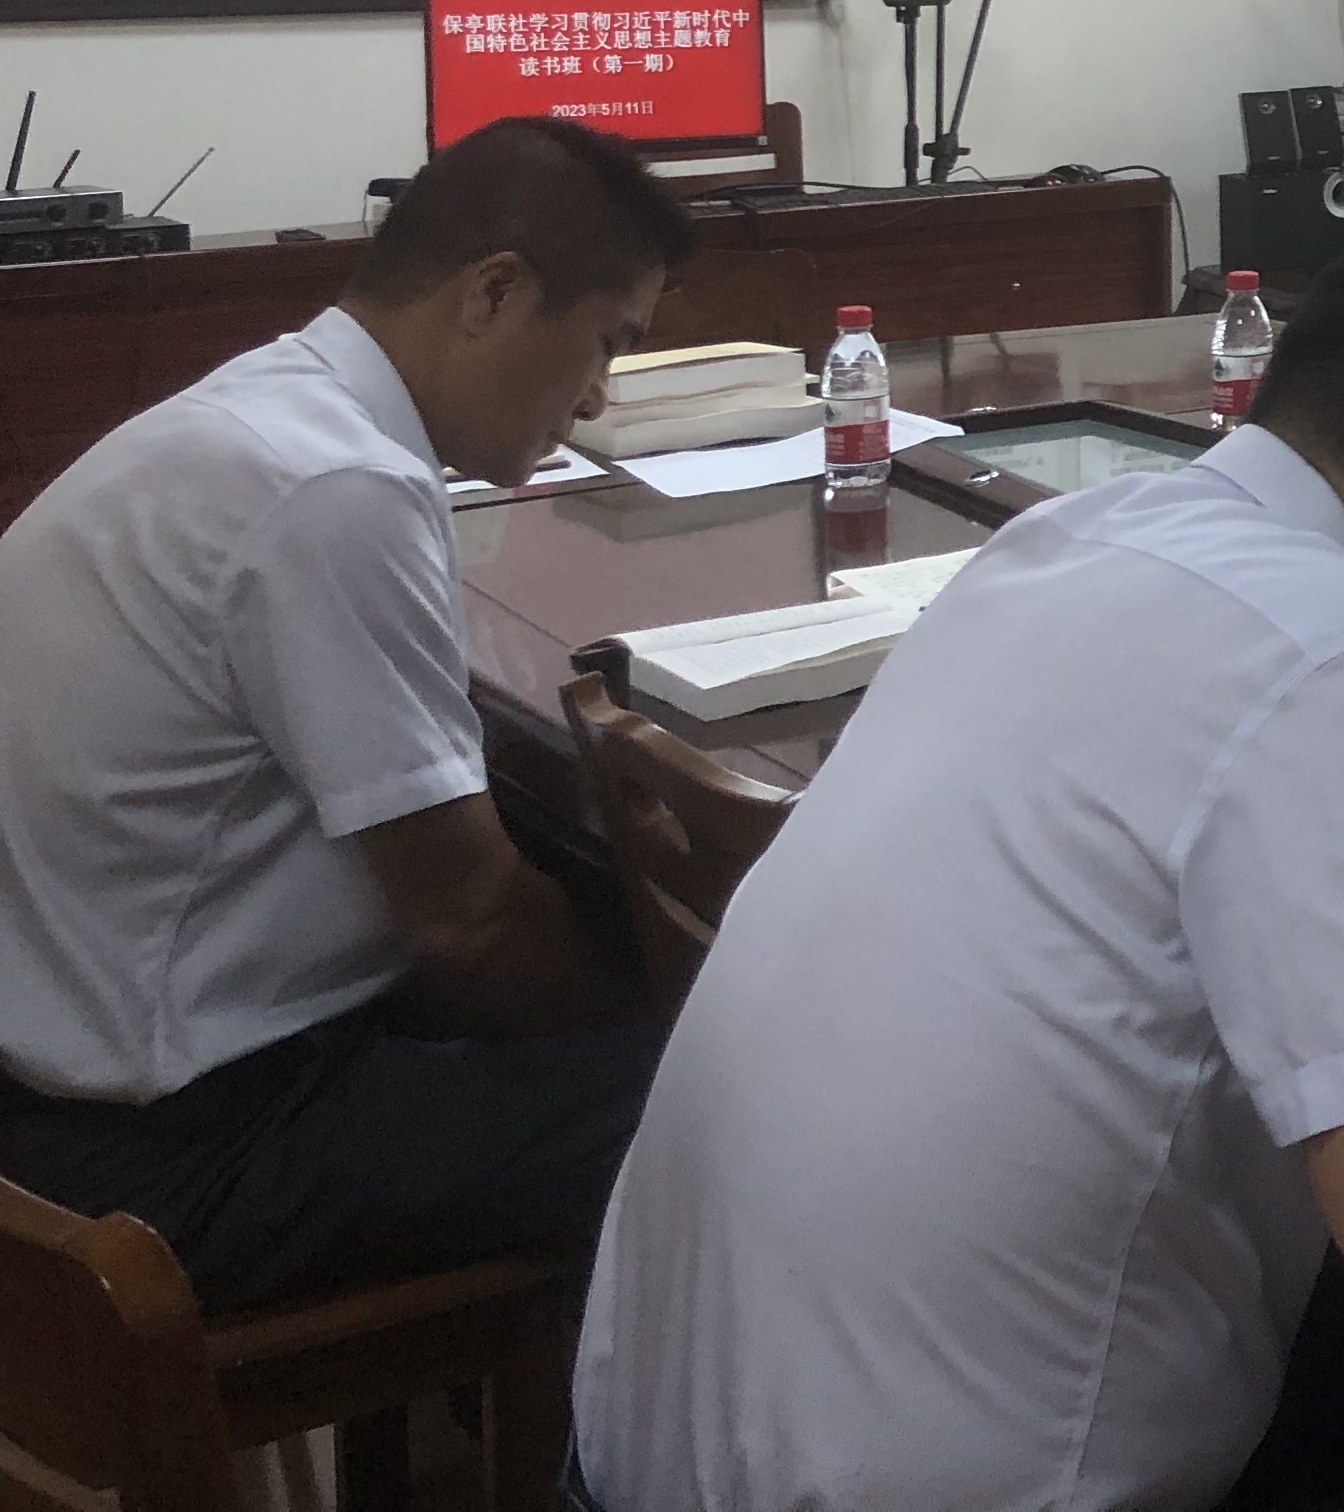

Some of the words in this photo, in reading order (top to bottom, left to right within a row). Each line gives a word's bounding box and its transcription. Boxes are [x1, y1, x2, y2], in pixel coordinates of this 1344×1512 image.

[442, 8, 751, 35] 保亭联社学习贯彻习近平新时代中
[465, 28, 731, 54] 国特色社会主义思想主题教育
[518, 53, 675, 77] 读书班（第一期）
[552, 100, 654, 118] 2023年5月11日
